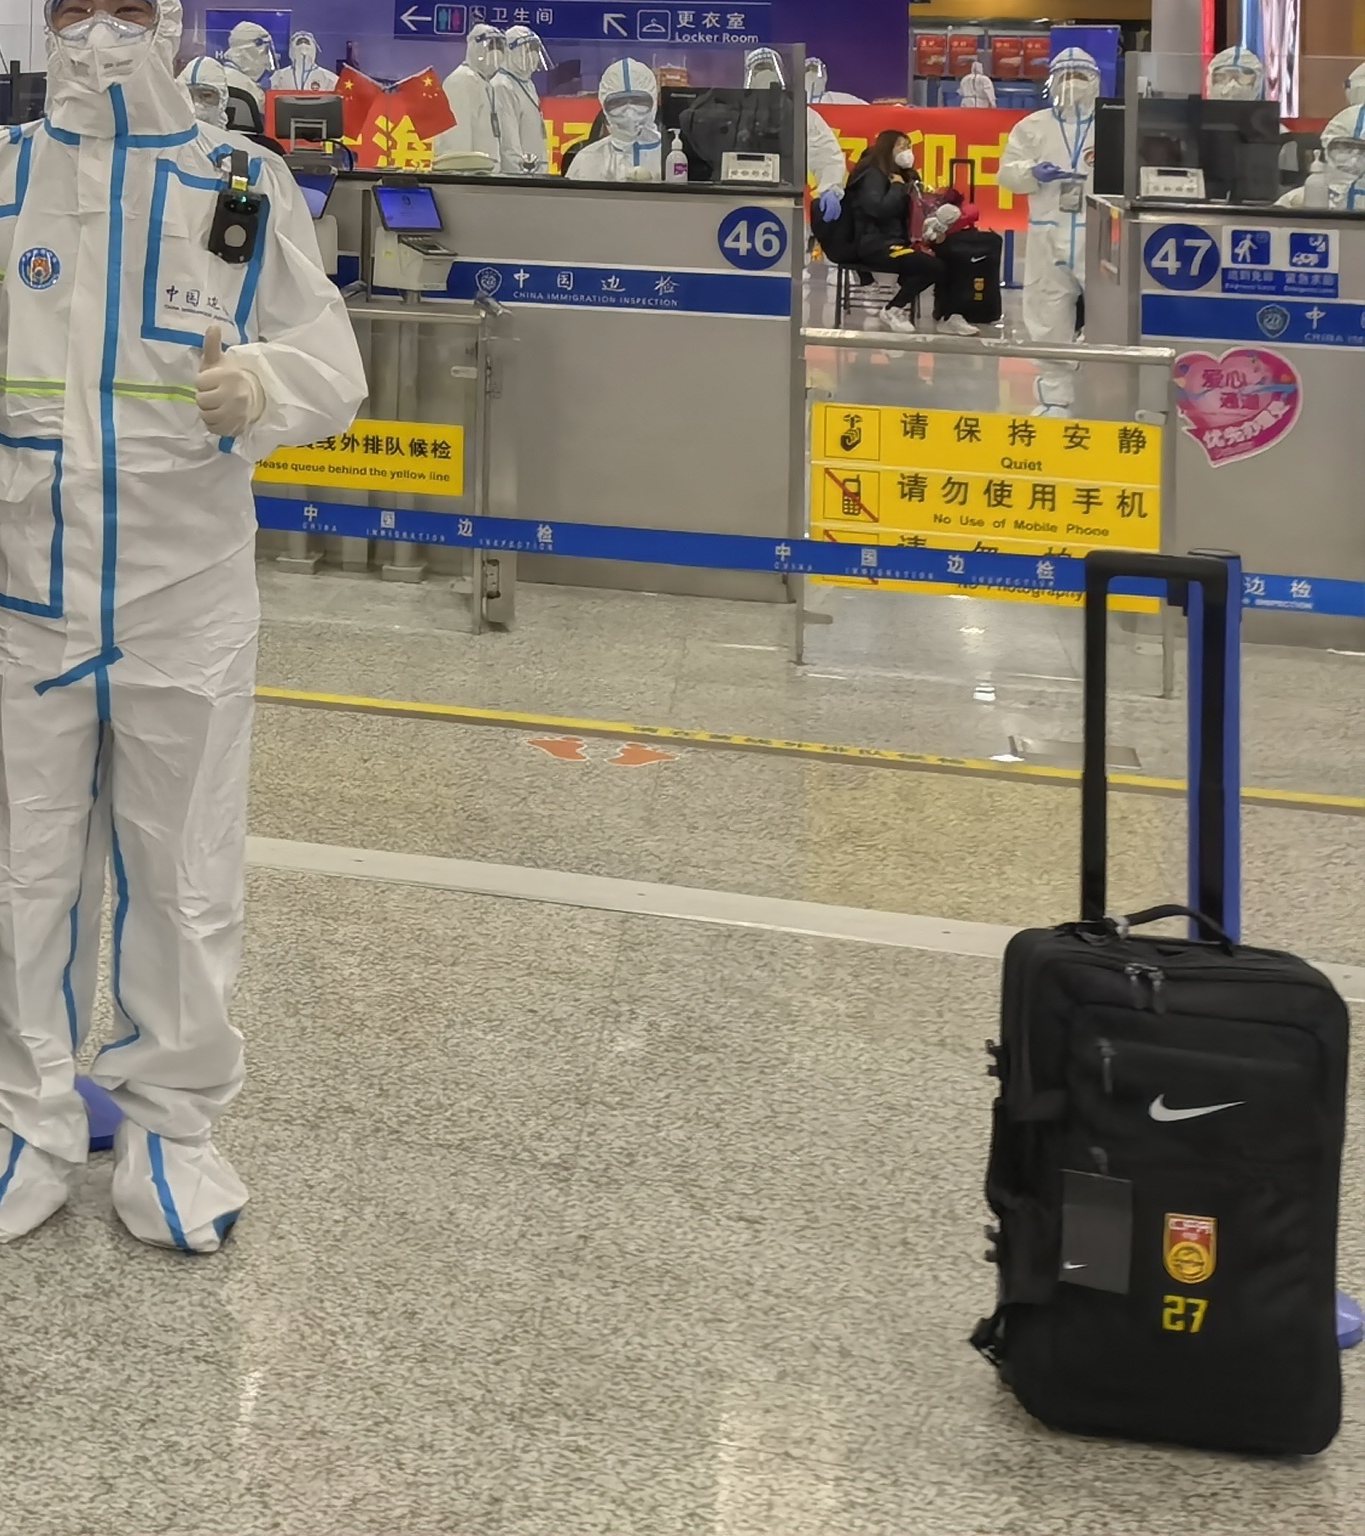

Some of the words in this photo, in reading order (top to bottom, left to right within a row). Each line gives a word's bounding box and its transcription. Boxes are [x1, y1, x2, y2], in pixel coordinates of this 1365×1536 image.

[491, 6, 554, 26] 卫生间
[676, 10, 746, 30] 更衣室
[676, 31, 719, 43] Locker
[722, 33, 759, 44] Room
[723, 220, 781, 258] 46
[1151, 237, 1213, 276] 47
[513, 268, 680, 296] 中国边检
[513, 291, 544, 301] CHINA
[547, 293, 616, 304] IMMIGRATION
[620, 297, 678, 307] INSPECTION
[1202, 368, 1247, 389] 爱心
[900, 412, 1147, 455] 请保持安静
[290, 463, 326, 474] queue
[328, 463, 367, 476] behind
[369, 467, 387, 477] the
[389, 470, 426, 481] yellow
[429, 471, 450, 482] line
[1000, 456, 1042, 472] Quiet
[897, 472, 1148, 520] 请勿使用手机
[303, 504, 554, 544] 中国边检
[933, 513, 951, 525] No
[959, 515, 985, 527] Use
[993, 517, 1006, 529] of
[1014, 519, 1058, 533] Mobile
[1066, 523, 1110, 537] Phone
[774, 543, 1055, 580] 中国边检
[1162, 1295, 1210, 1334] 27
